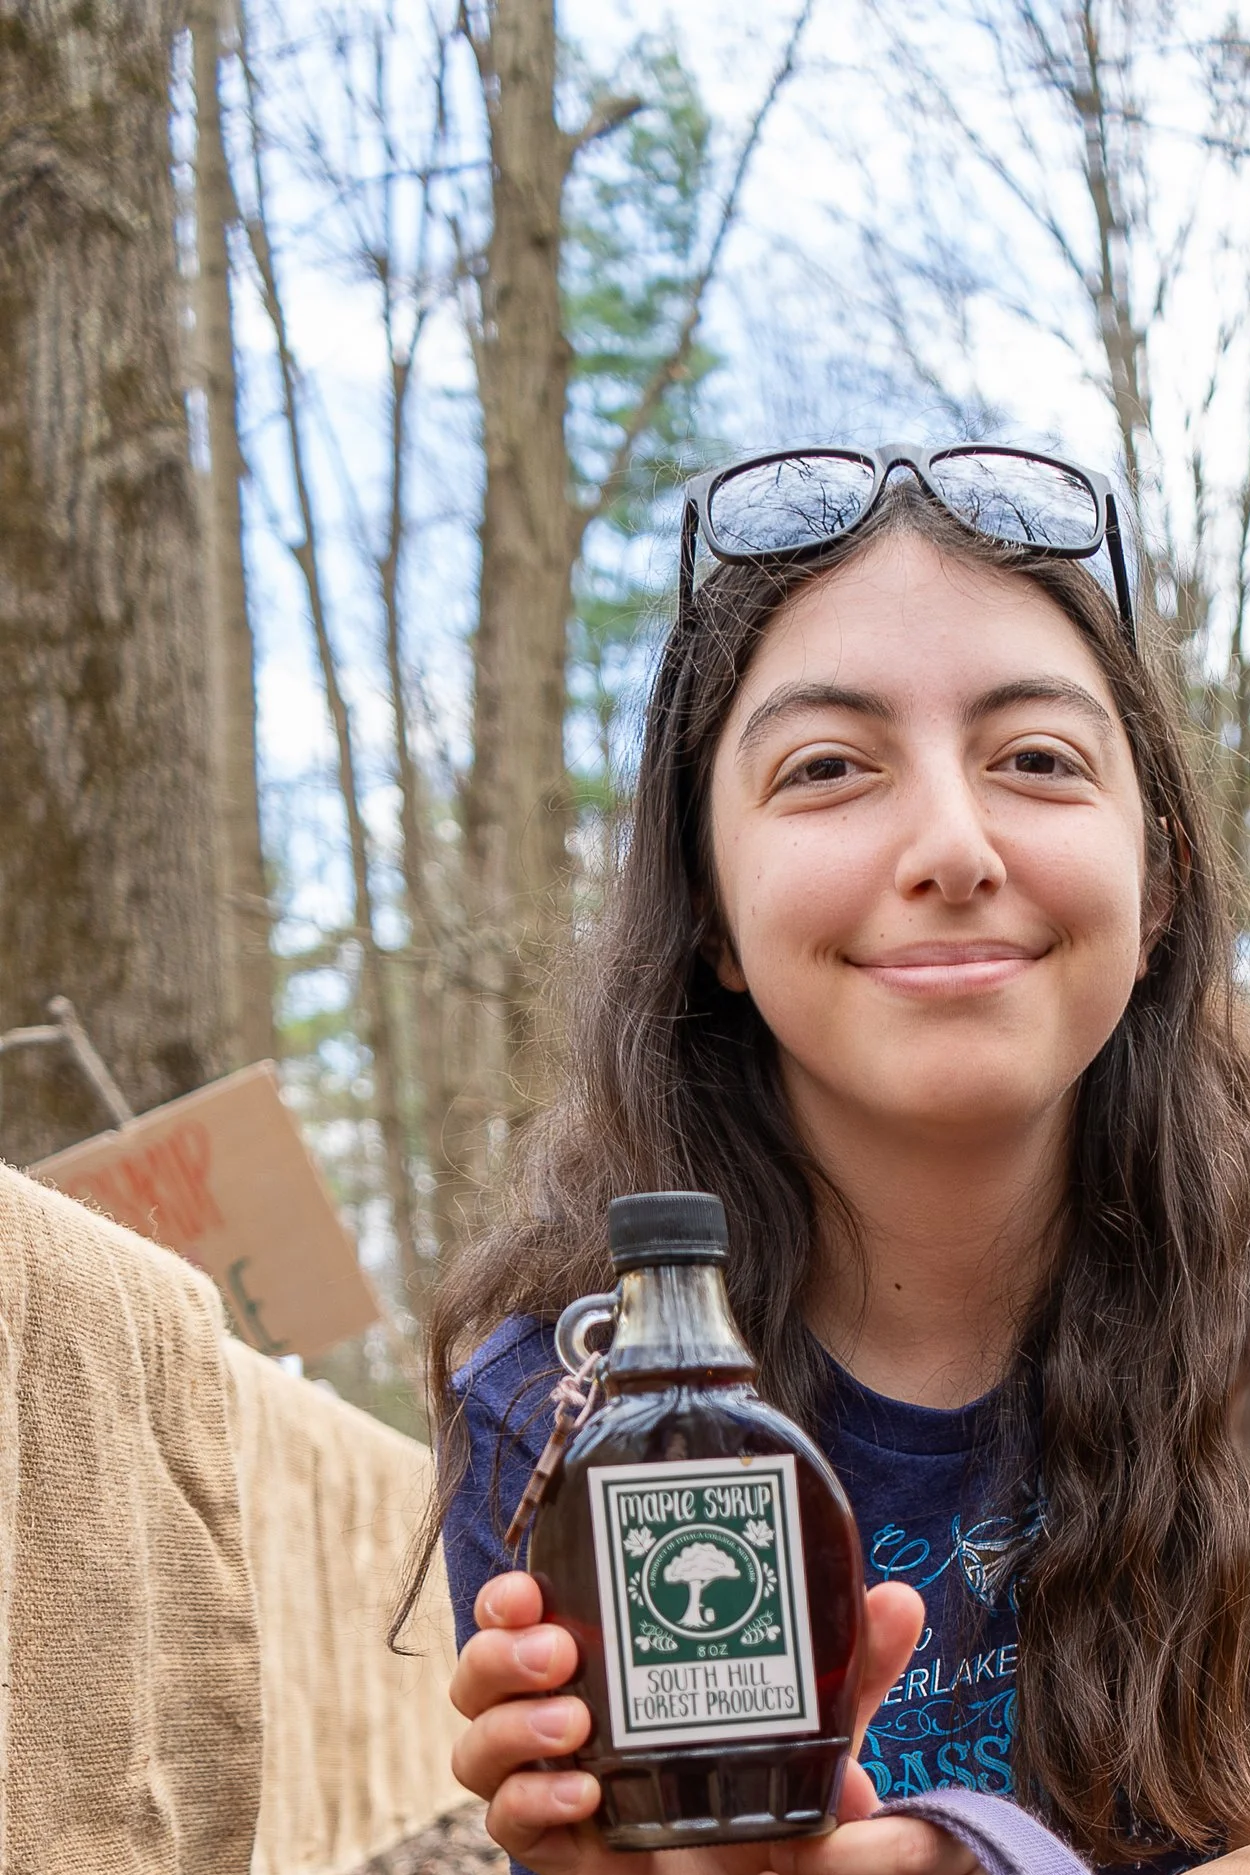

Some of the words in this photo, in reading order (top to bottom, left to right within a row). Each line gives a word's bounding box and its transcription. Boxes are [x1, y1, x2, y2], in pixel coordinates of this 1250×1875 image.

[703, 1485, 771, 1518] SYRUP
[650, 1551, 668, 1581] PRODUCT
[697, 1646, 706, 1658] 8
[709, 1643, 729, 1656] OZ
[647, 1666, 718, 1694] SOUTH
[728, 1662, 771, 1687] HILL
[633, 1692, 699, 1721] FOREST
[706, 1685, 794, 1716] PRODUCTS
